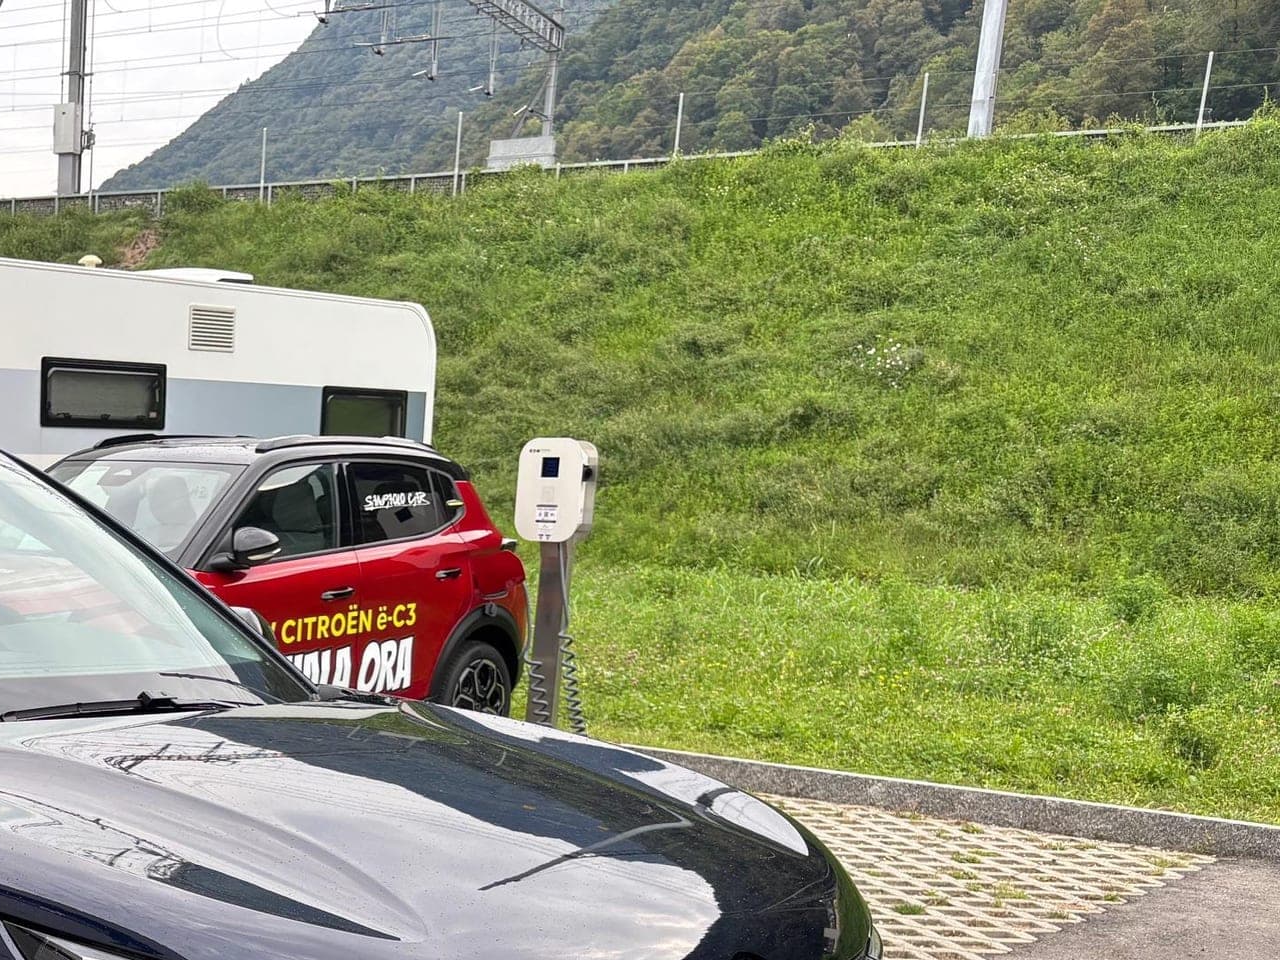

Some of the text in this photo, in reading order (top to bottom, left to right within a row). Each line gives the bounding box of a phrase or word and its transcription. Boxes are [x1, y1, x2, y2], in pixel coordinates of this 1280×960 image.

[281, 602, 417, 644] CITROËN ë-C3
[356, 635, 414, 694] ORA
